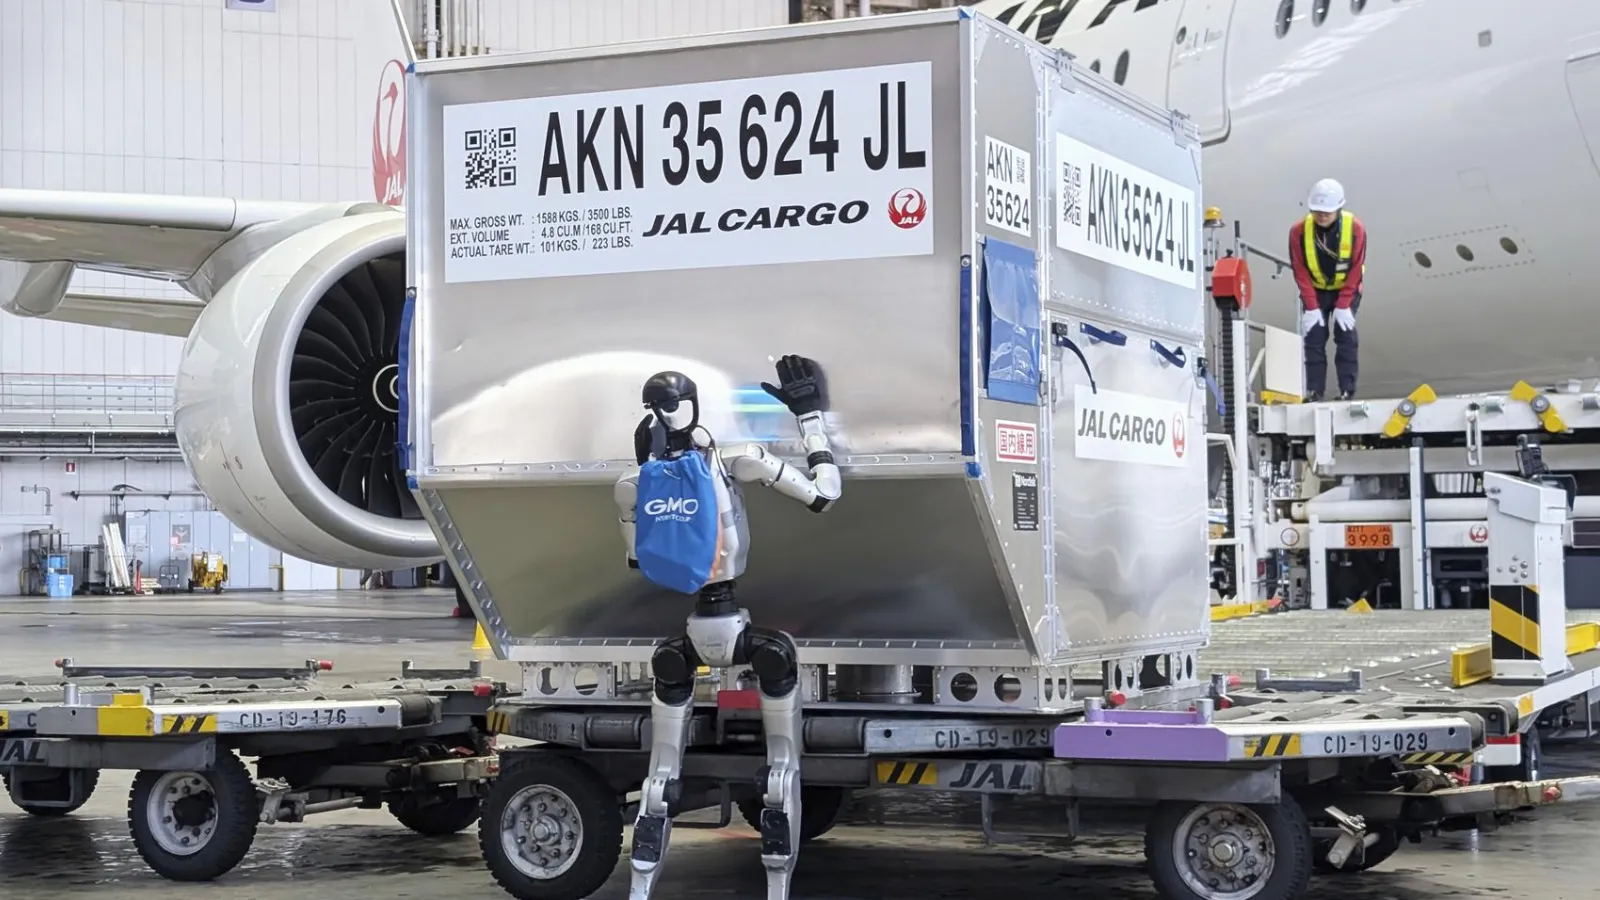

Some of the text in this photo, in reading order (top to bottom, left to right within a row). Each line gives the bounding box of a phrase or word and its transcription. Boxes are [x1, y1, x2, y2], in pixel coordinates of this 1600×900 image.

[538, 103, 645, 196] AKN
[863, 81, 927, 171] JL
[986, 141, 1013, 184] AKN
[382, 170, 404, 204] JAL
[450, 217, 472, 230] MAX.
[474, 215, 506, 229] GROSS
[508, 213, 525, 227] WT.
[536, 211, 558, 224] 1588
[559, 209, 581, 222] KGS.
[587, 207, 610, 221] 3500
[611, 206, 633, 219] LBS.
[717, 200, 869, 231] CARGO
[986, 185, 1030, 230] 35624
[897, 216, 921, 225] JAL
[450, 232, 470, 245] EXT.
[471, 229, 510, 243] VOLUME
[541, 226, 555, 239] 4.8
[556, 224, 581, 238] CU.M
[602, 221, 633, 235] CU.FT.
[450, 245, 488, 259] ACTUAL
[488, 243, 514, 256] TARE
[540, 241, 556, 253] 101
[557, 239, 581, 252] KGS.
[592, 237, 609, 250] 223
[611, 235, 633, 248] LBS.
[644, 497, 699, 515] GMO
[1347, 533, 1390, 546] 3998
[240, 709, 347, 728] CD-19-176
[935, 728, 1050, 749] CD-19-029
[1324, 732, 1428, 754] CD-19-029
[949, 763, 1033, 790] JAL
